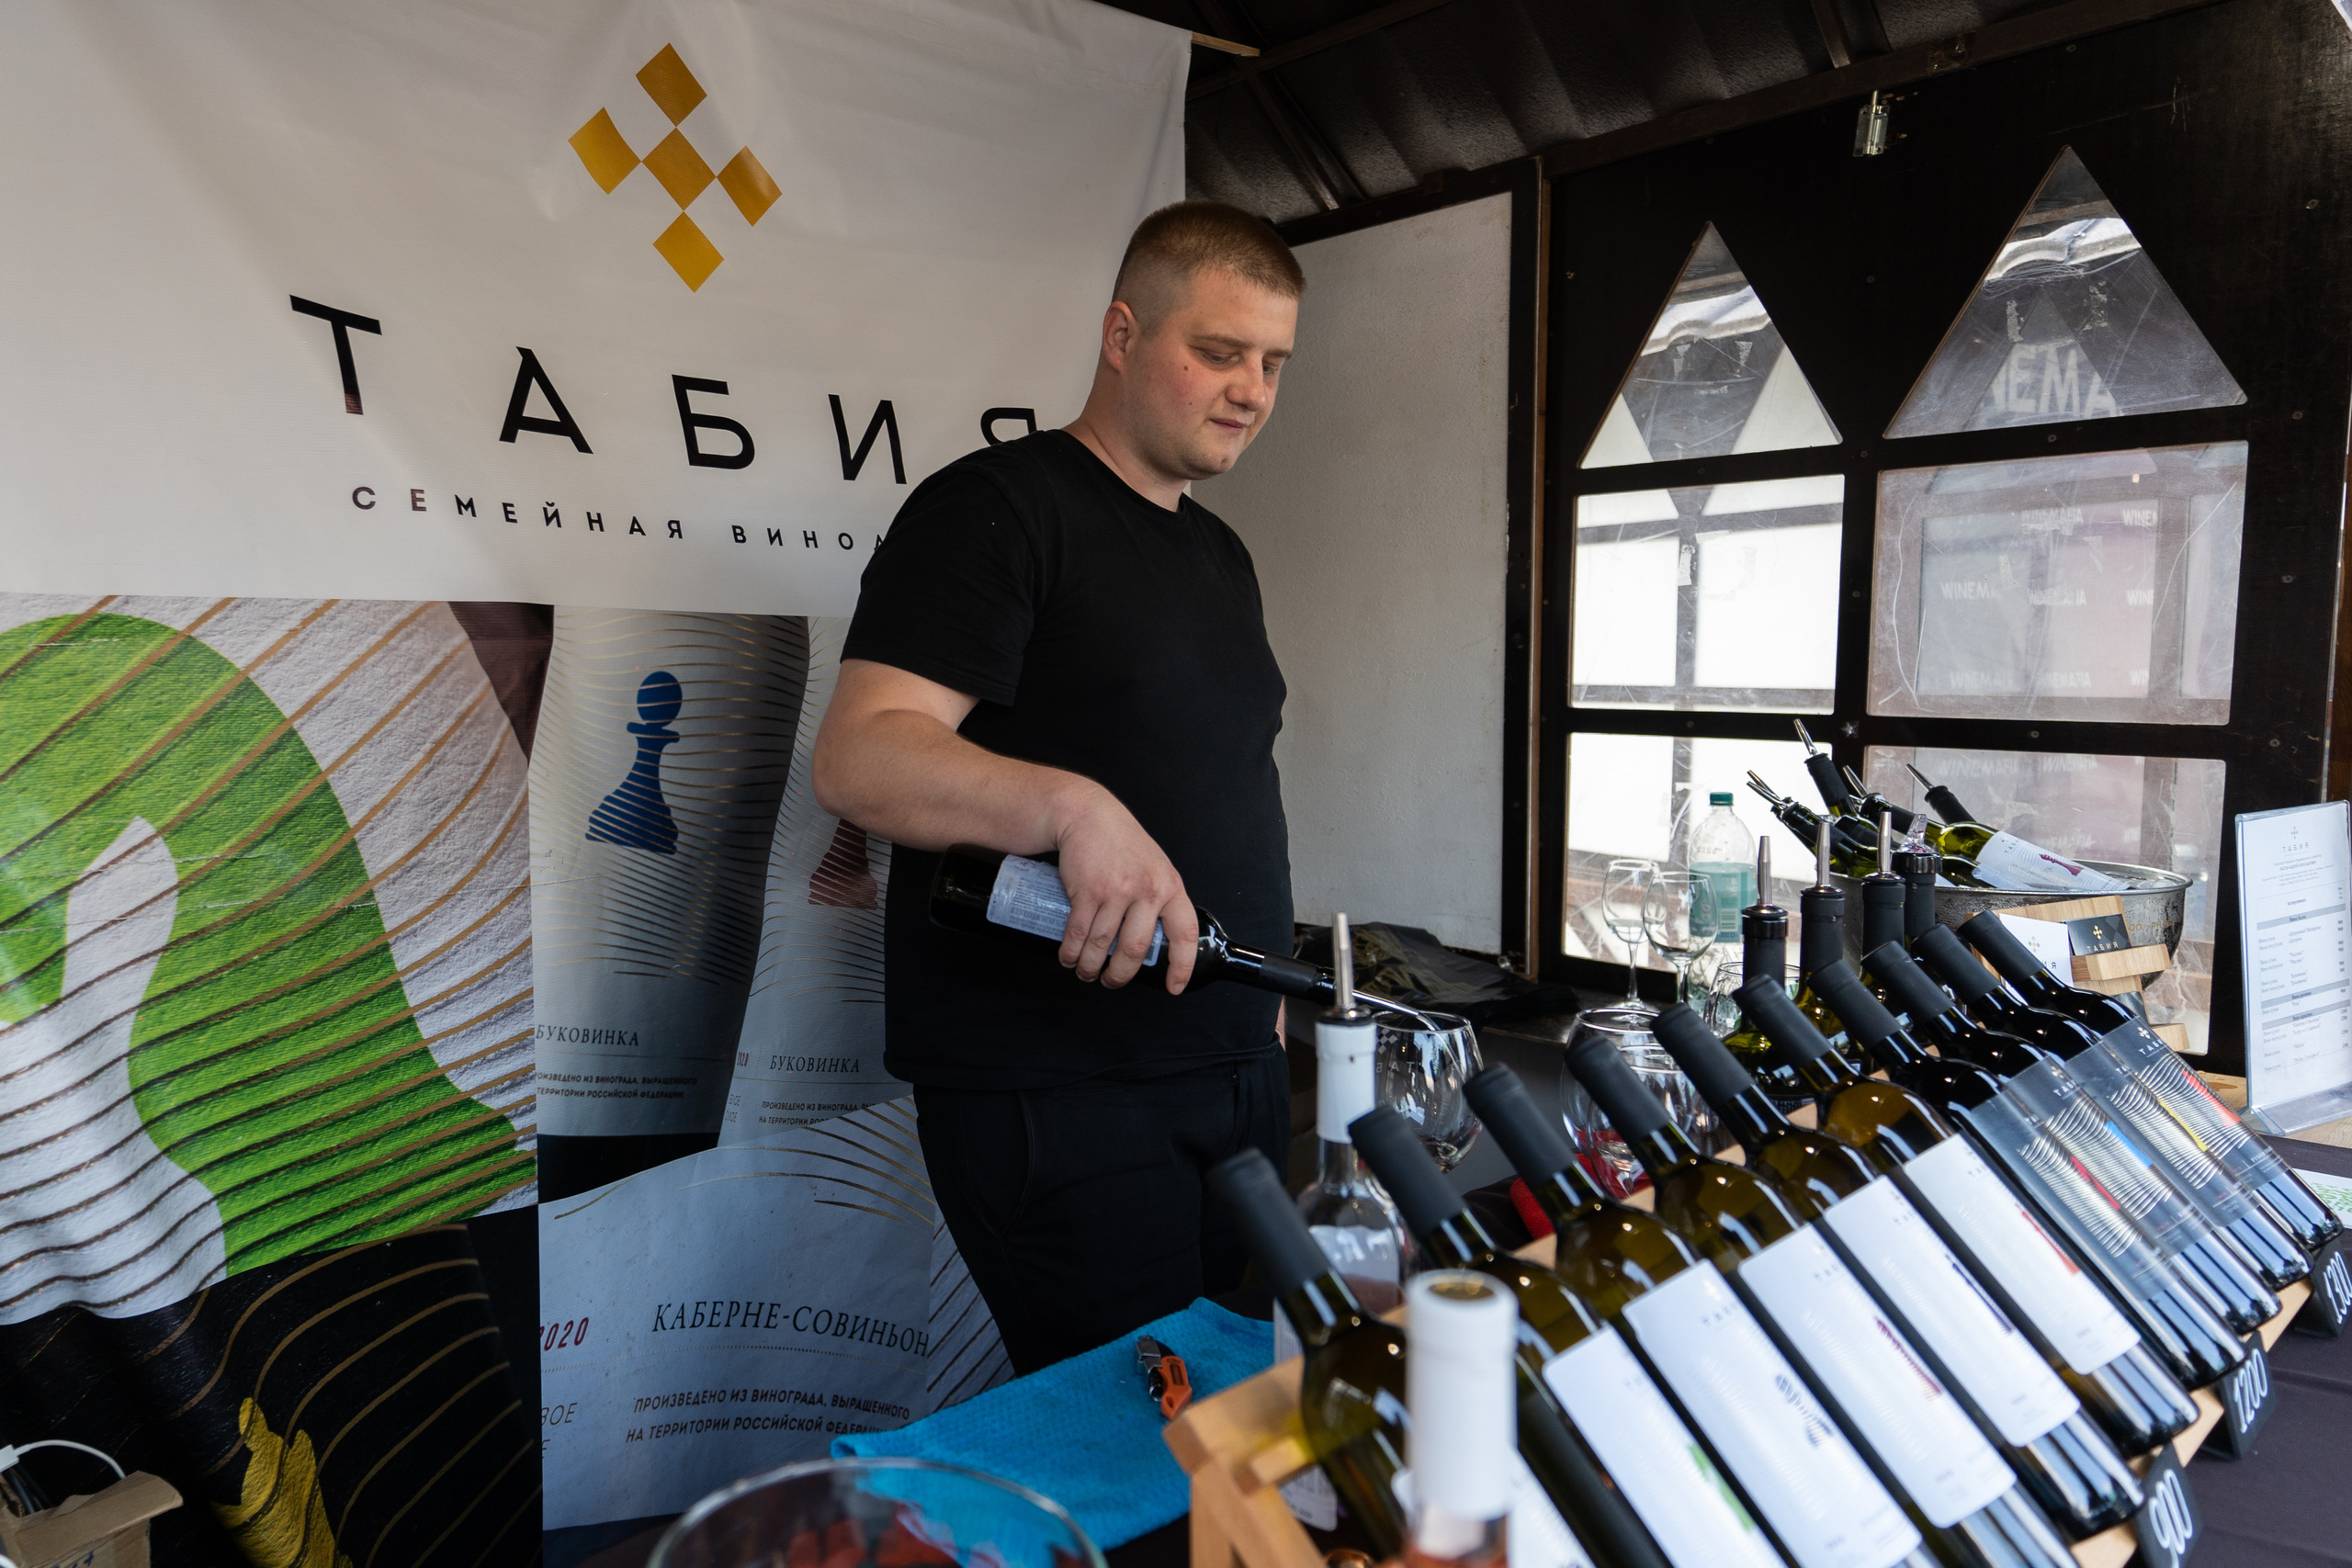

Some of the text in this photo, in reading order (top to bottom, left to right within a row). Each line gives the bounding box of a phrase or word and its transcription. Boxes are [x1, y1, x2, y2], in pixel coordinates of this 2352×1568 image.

[352, 486, 684, 541] СЕМЕЙНАЯ
[2086, 942, 2120, 953] ТАБИЯ
[536, 1024, 640, 1046] БУКОВИНКА
[770, 1055, 860, 1073] БУКОВИНКА
[535, 1072, 582, 1083] ОИЗВЕДЕНО
[583, 1075, 594, 1084] ИЗ
[595, 1076, 639, 1085] ВИНОГРАДА,
[537, 1087, 585, 1097] ТЕРРИТОРИИ
[587, 1089, 639, 1099] РОССИЙСКОЙ
[761, 1101, 805, 1111] ПРОИЗВЕДЕНО
[807, 1101, 816, 1111] ИЗ
[817, 1102, 859, 1111] ВИНОГРАДА,
[759, 1115, 767, 1124] НА
[768, 1116, 808, 1126] ТЕРРИТОРИИ
[651, 1301, 930, 1357] КАБЕРНЕ-СОВИНЬОН
[2233, 1348, 2267, 1435] 1200
[633, 1389, 910, 1420] ПРОИЗВЕДЕНО ИЗ ВИНОГРАДА, ВЫРАЩЕННОГО
[626, 1427, 643, 1443] НА
[649, 1417, 729, 1440] ТЕРРИТОРИИ
[733, 1414, 822, 1432] РОССИЙСКОЙ
